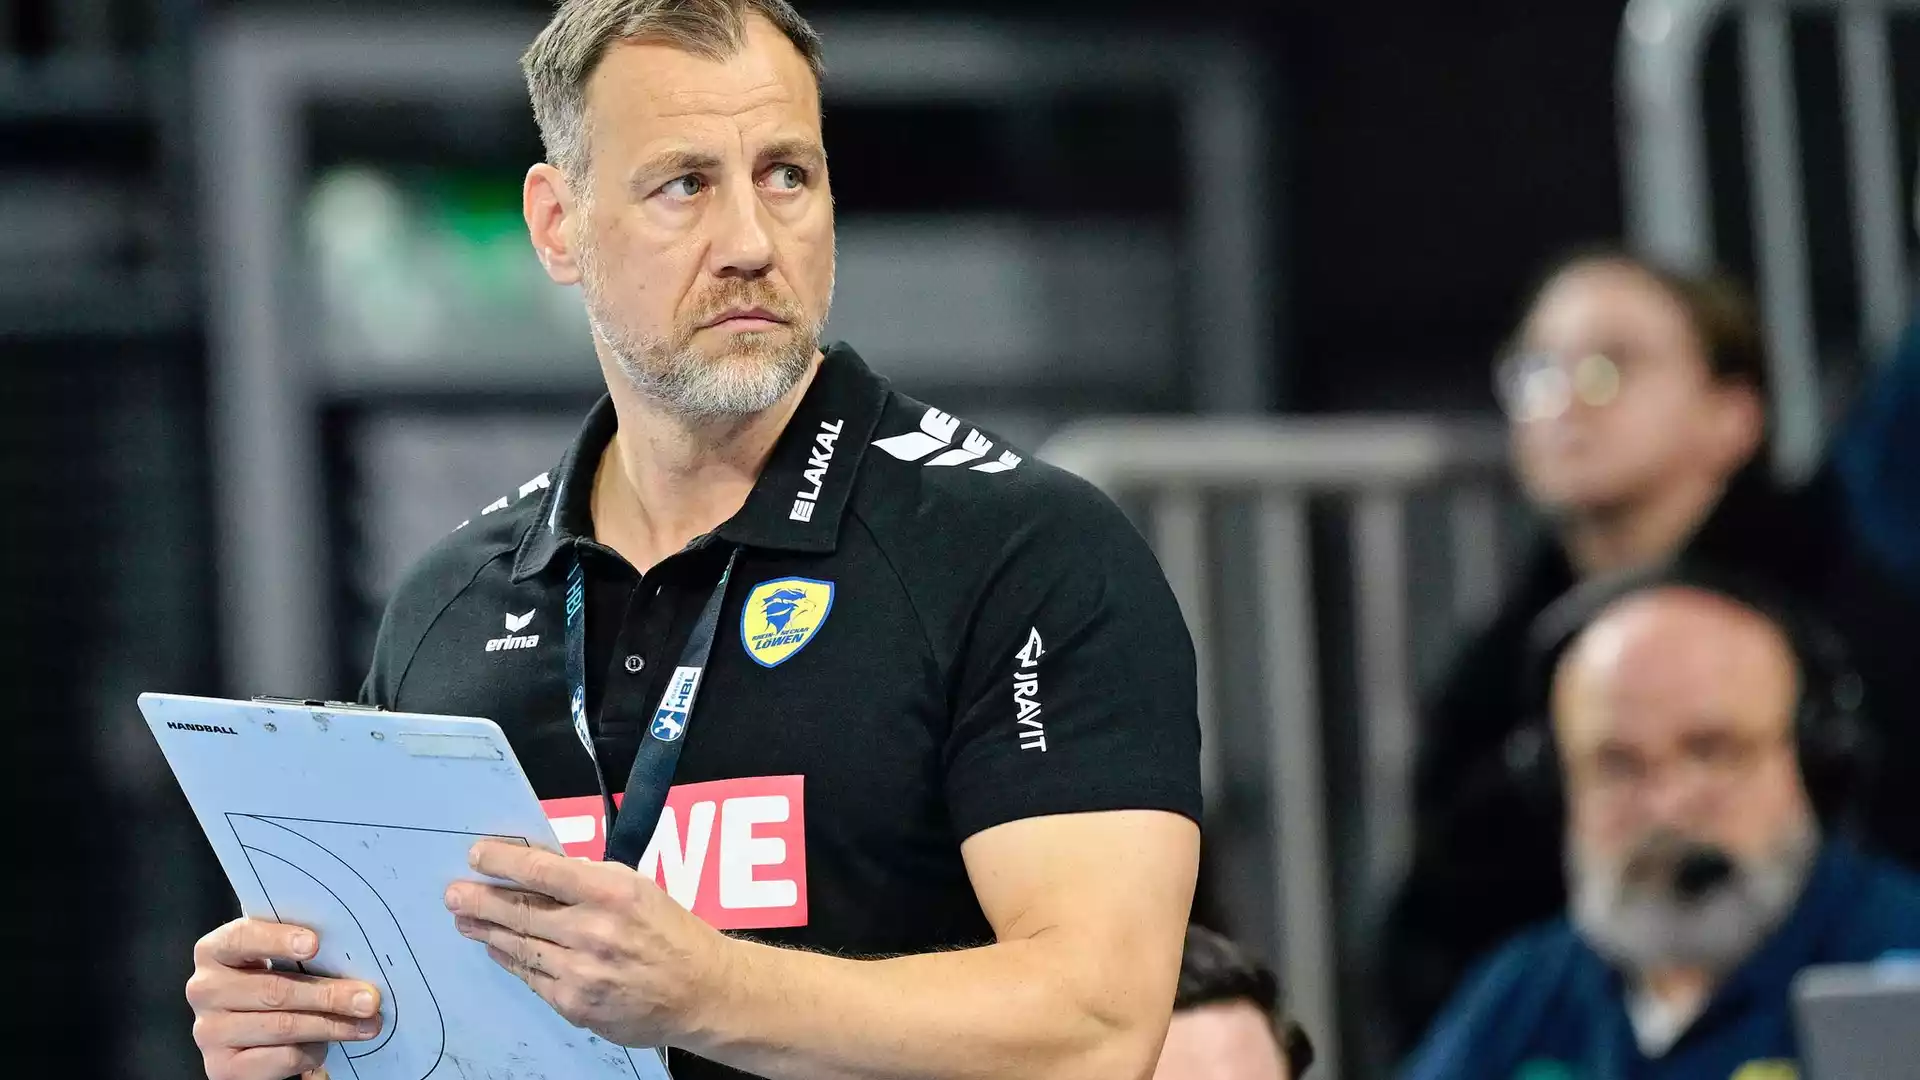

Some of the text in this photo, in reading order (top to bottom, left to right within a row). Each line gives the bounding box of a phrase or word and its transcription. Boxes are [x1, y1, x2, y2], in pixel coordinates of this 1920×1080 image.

[566, 576, 582, 627] HBL
[485, 634, 540, 652] erima
[754, 633, 804, 650] LÖWEN
[675, 671, 697, 708] HBL
[166, 721, 239, 735] HANDBALL
